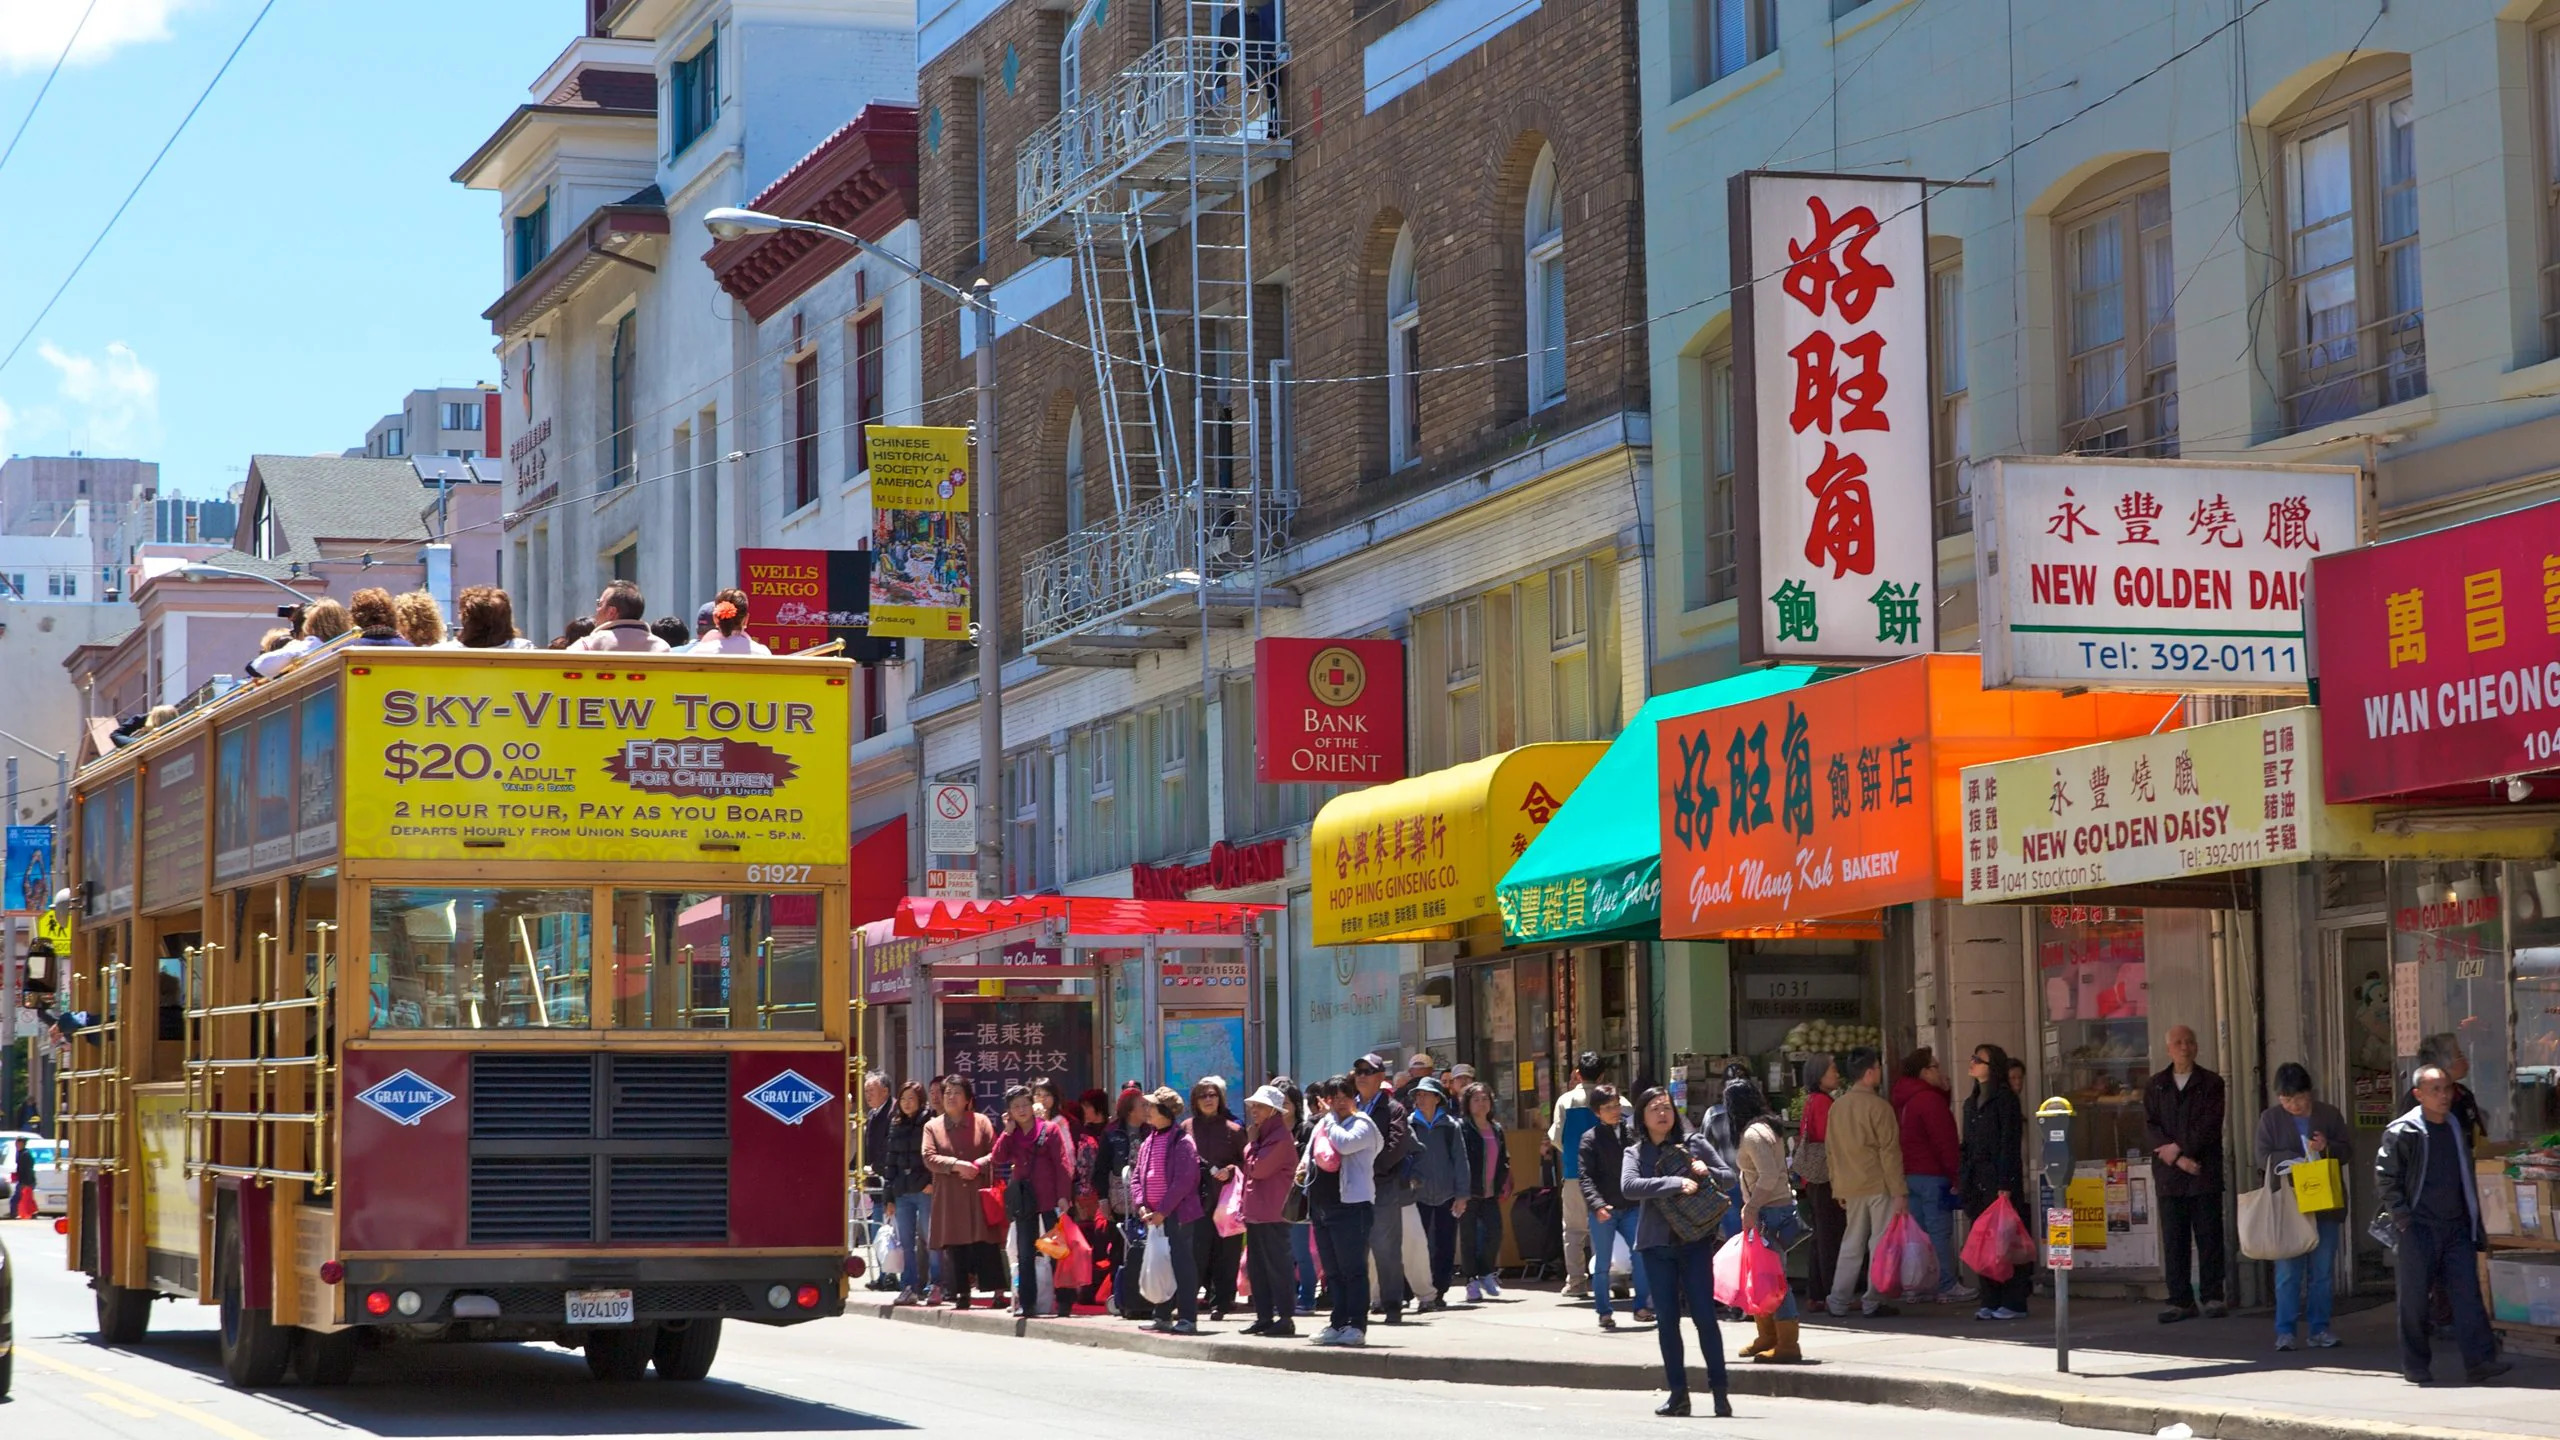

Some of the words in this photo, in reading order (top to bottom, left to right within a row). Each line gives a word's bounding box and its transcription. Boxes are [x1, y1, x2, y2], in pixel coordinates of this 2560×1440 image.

[1782, 195, 1894, 579] 好旺角
[872, 438, 930, 448] CHINESE
[873, 451, 949, 462] HISTORICAL
[875, 464, 929, 474] SOCIETY
[876, 477, 933, 488] AMERICA
[876, 495, 935, 505] MUSEUM
[2046, 485, 2320, 552] 永豐燒臘
[749, 564, 819, 580] WELLS
[751, 582, 819, 597] FARGO
[2031, 564, 2097, 606] NEW
[2114, 566, 2232, 611] GOLDEN
[875, 616, 916, 626] chsa.org
[2079, 641, 2138, 670] Tel:
[2150, 643, 2297, 673] 392-0111
[2364, 687, 2429, 740] WAN
[2437, 661, 2560, 728] CHEONG
[383, 689, 656, 729] SKY-VIEW
[674, 693, 815, 732] TOUR
[1304, 709, 1368, 732] BANK
[1315, 738, 1332, 748] OF
[1335, 738, 1359, 748] THE
[625, 739, 724, 769] FREE
[1292, 749, 1382, 772] ORIENT
[509, 766, 576, 781] ADULT
[629, 770, 670, 786] FOR
[672, 771, 774, 788] CHILDREN
[1674, 700, 1813, 851] 好旺角
[502, 783, 533, 791] VALID
[537, 783, 544, 791] 2
[547, 783, 576, 791] DAYS
[703, 787, 719, 796] (11
[735, 788, 774, 797] UNDER)
[394, 802, 410, 818] 2
[421, 804, 488, 819] HOUR
[498, 804, 568, 821] TOUR,
[579, 803, 624, 820] PAY
[633, 806, 660, 820] AS
[672, 806, 716, 820] YOU
[727, 806, 803, 822] BOARD
[391, 825, 457, 836] DEPARTS
[463, 826, 525, 837] HOURLY
[531, 827, 571, 836] FROM
[577, 826, 624, 837] UNION
[630, 828, 688, 838] SQUARE
[704, 829, 750, 839] 10A.M.
[769, 830, 806, 840] 5P.M.
[2022, 829, 2067, 864] NEW
[2073, 815, 2157, 856] GOLDEN
[2164, 805, 2231, 843] DAISY
[23, 838, 49, 846] YMCA
[2180, 847, 2201, 868] Tel:
[2206, 840, 2260, 866] 392-0111
[746, 865, 811, 883] 61927
[929, 872, 944, 886] NO
[1131, 862, 1182, 900] BANK
[1210, 840, 1287, 890] ORIENT
[2001, 871, 2027, 893] 1041
[2032, 866, 2087, 890] Stockton
[2090, 863, 2106, 883] St.
[1329, 887, 1353, 910] HOP
[1356, 880, 1383, 905] HING
[1386, 869, 1437, 899] GINSENG
[1439, 865, 1459, 888] CO.
[1689, 866, 1733, 923] Good
[1739, 859, 1793, 911] Mang
[1795, 846, 1834, 891] Kok
[1842, 851, 1899, 882] BAKERY
[1591, 879, 1621, 924] Yue
[2422, 901, 2463, 929] GOLDEN
[1216, 966, 1246, 974] 16526
[2458, 961, 2483, 978] 1041
[1770, 981, 1809, 998] 1031
[954, 1023, 1045, 1045] 一張乘搭
[954, 1051, 1069, 1073] 各類公共交
[374, 1091, 406, 1103] GRAY
[408, 1091, 434, 1103] LINE
[761, 1091, 790, 1103] GRAY
[792, 1091, 816, 1103] LINE
[571, 1302, 628, 1318] 8V24109
